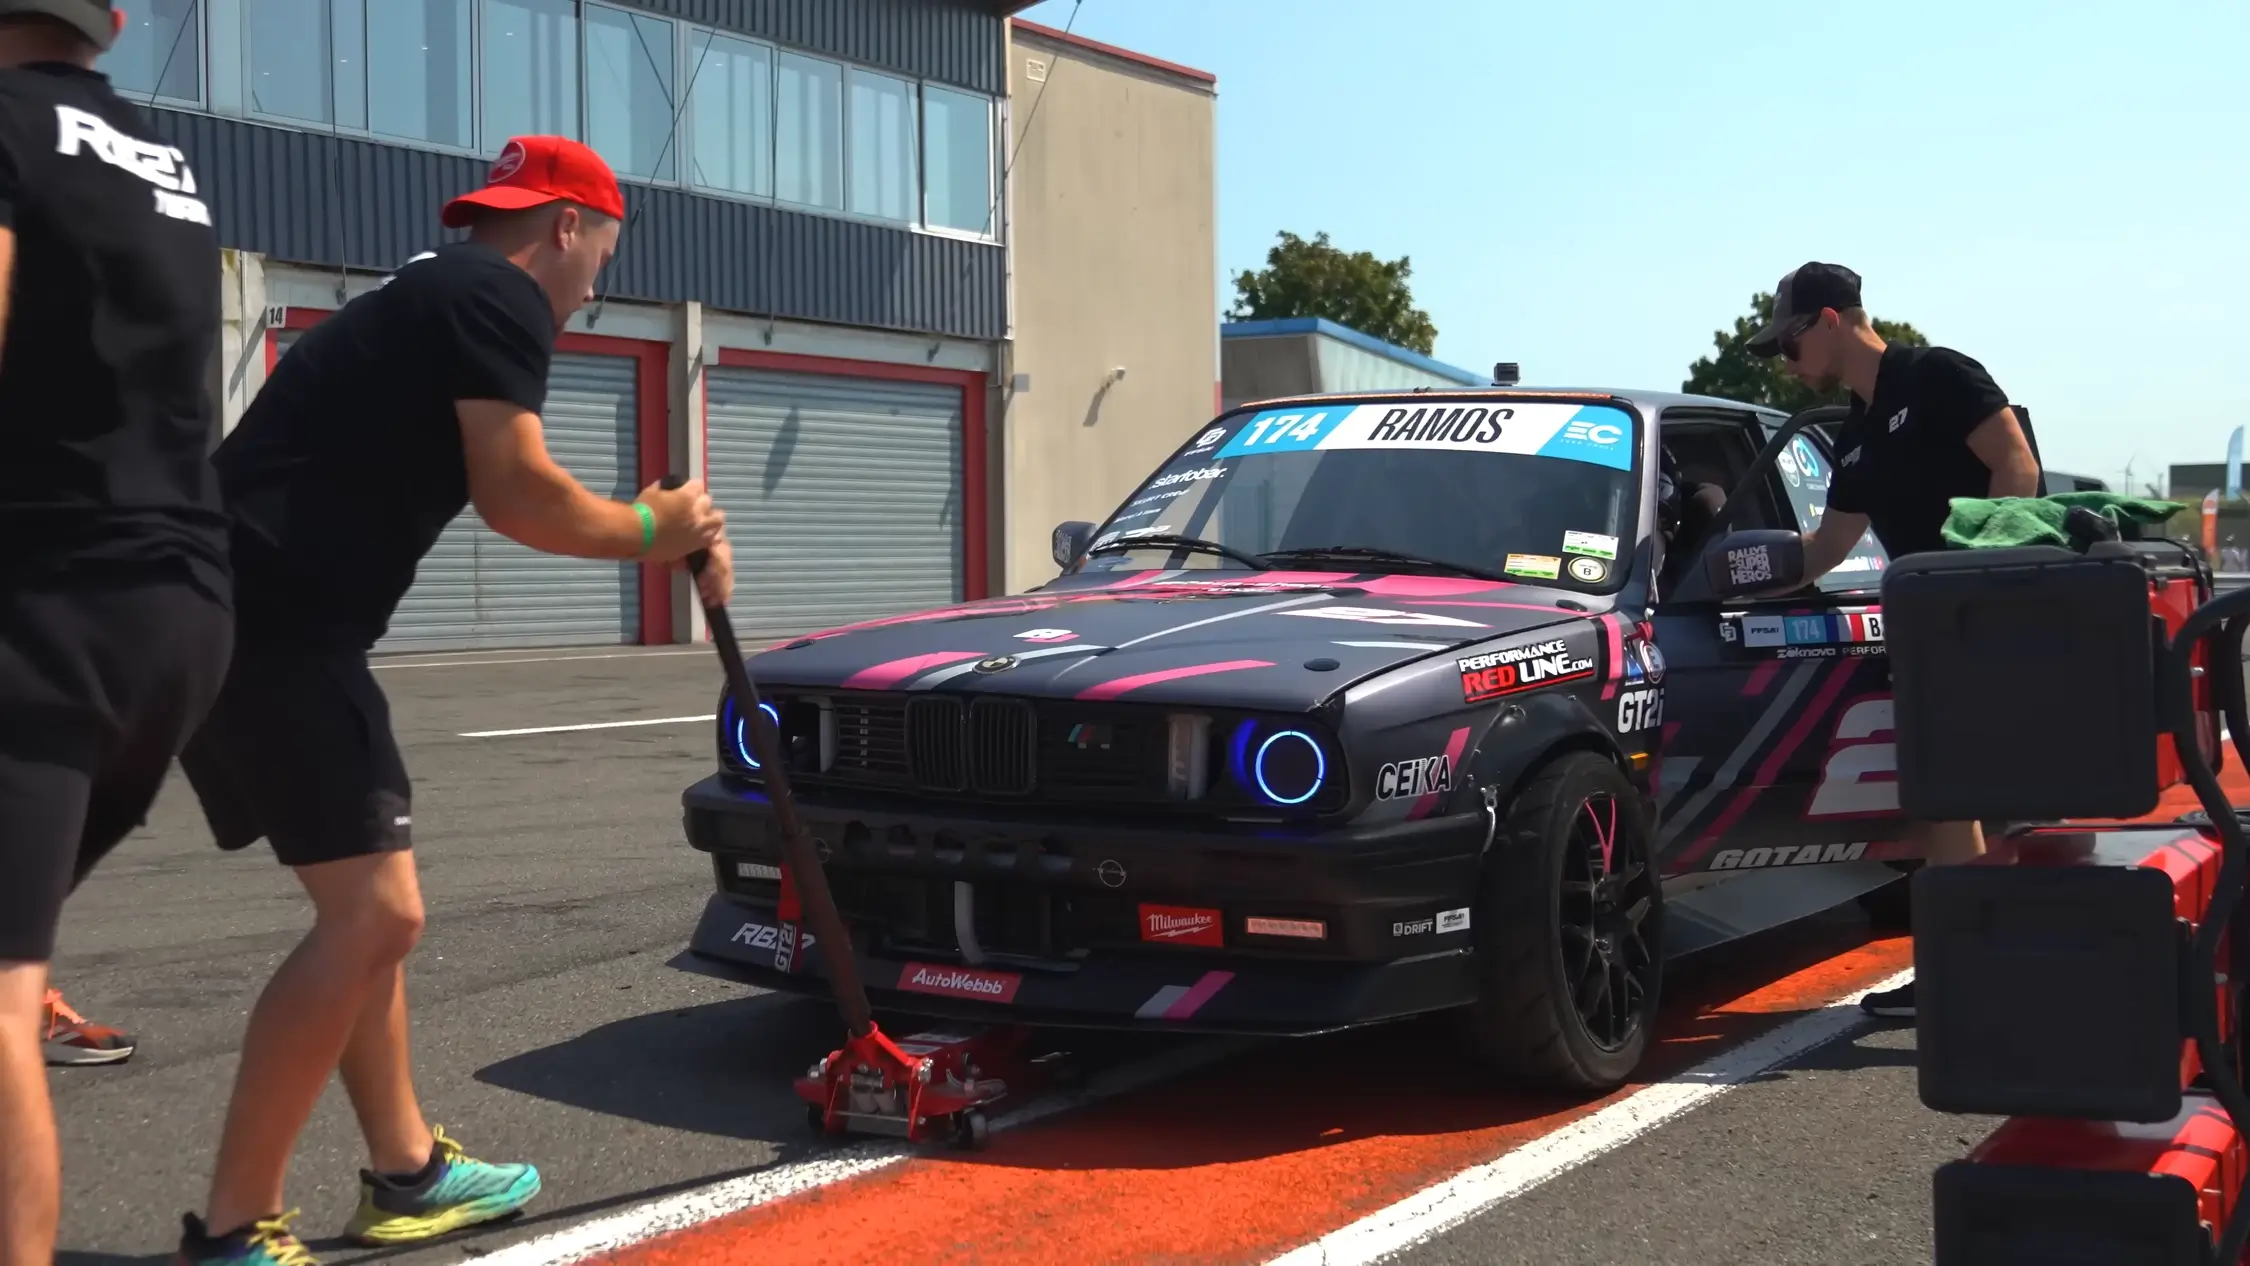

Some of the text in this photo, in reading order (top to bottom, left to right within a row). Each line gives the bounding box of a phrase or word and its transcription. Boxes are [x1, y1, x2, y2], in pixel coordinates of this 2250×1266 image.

[270, 306, 283, 325] 14
[1244, 412, 1328, 446] 174
[1367, 408, 1515, 443] RAMOS
[1888, 406, 1909, 433] 27
[1728, 545, 1768, 563] RALLYE
[1583, 567, 1592, 576] B
[1730, 569, 1772, 585] HEROS
[1791, 618, 1821, 641] 174
[1868, 617, 1885, 637] B
[1458, 640, 1567, 672] PERFORMANCE
[1462, 664, 1516, 695] RED
[1617, 688, 1665, 734] GT2i
[1709, 842, 1869, 870] GOTAM
[1146, 913, 1213, 932] Milwaukee
[1404, 921, 1433, 935] DRIFT
[730, 922, 816, 951] RB7
[911, 968, 1003, 994] AutoWebbb
